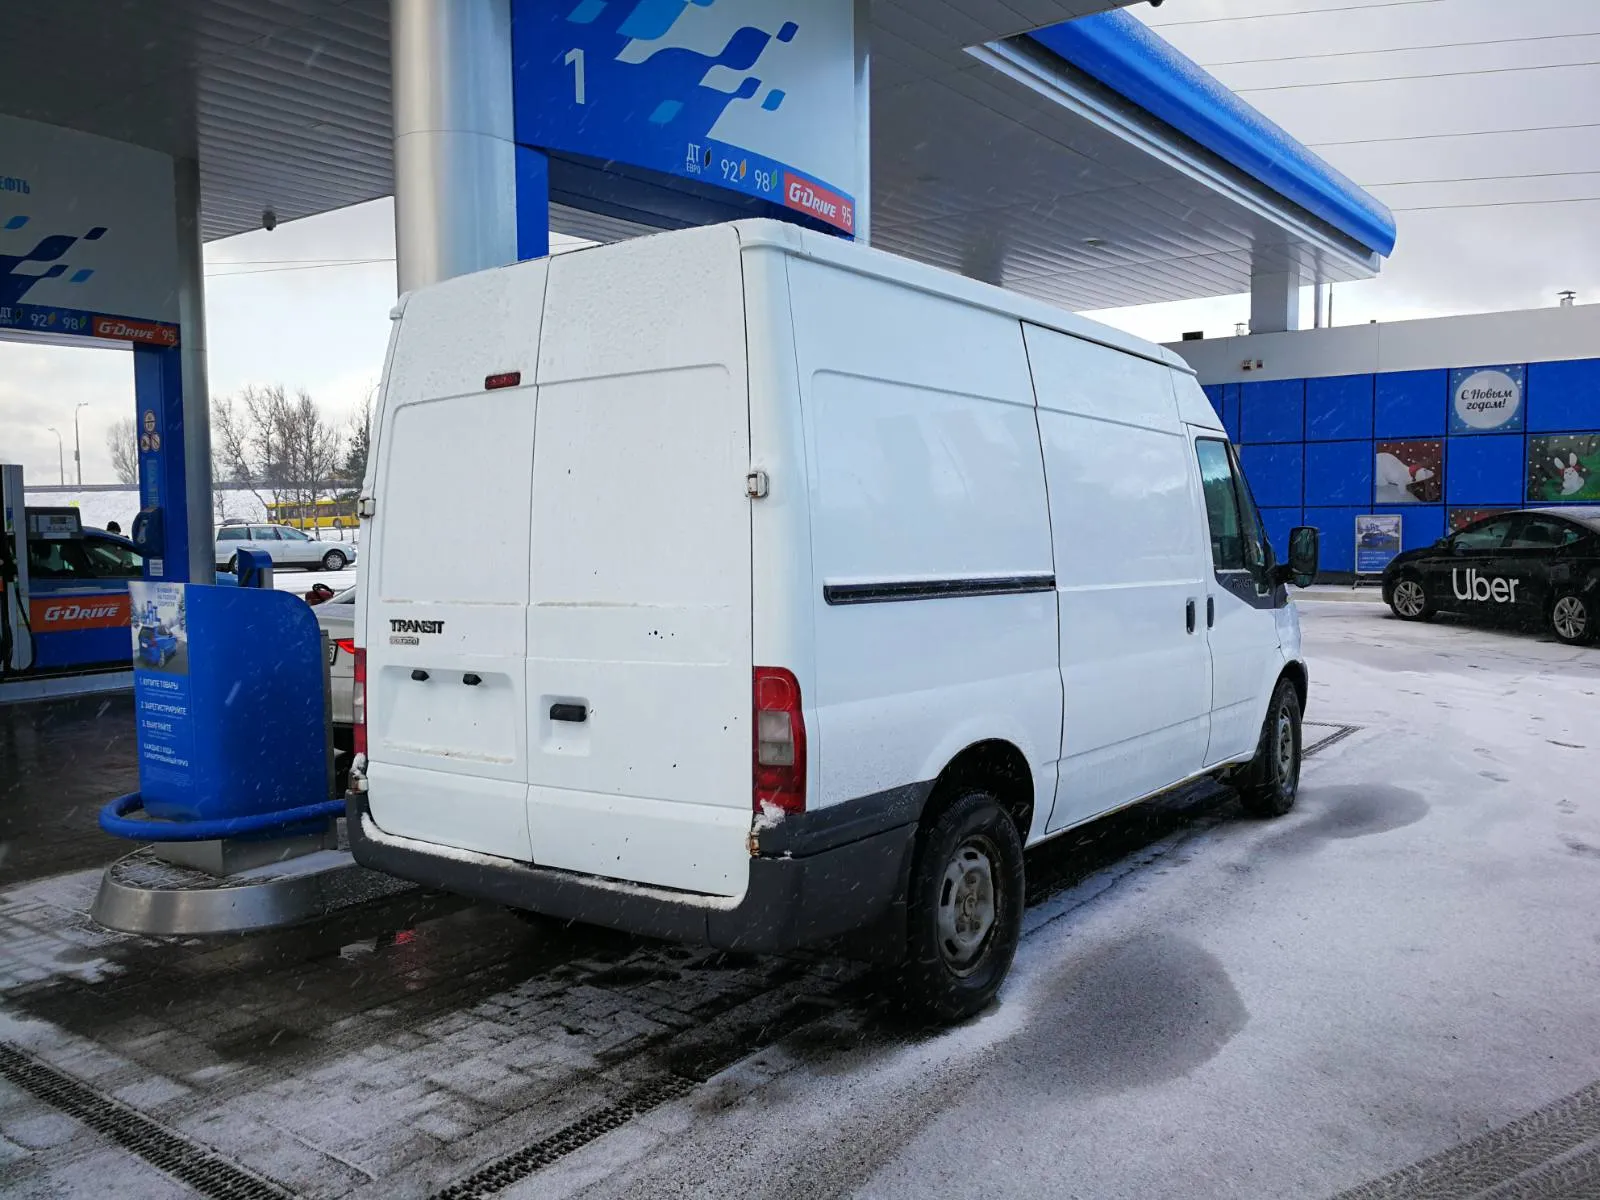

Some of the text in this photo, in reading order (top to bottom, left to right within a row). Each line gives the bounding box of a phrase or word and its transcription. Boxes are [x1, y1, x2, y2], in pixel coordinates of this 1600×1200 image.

[564, 48, 585, 105] 1
[686, 143, 770, 192] ДТ 92 98
[686, 162, 701, 174] ЕВРО
[841, 205, 852, 226] 95
[31, 313, 48, 327] 92
[63, 317, 79, 330] 98
[162, 329, 176, 342] 95
[1461, 387, 1513, 400] С Новым
[1466, 398, 1507, 412] годом!
[1452, 567, 1520, 603] Uber
[389, 619, 445, 634] TRANSIT
